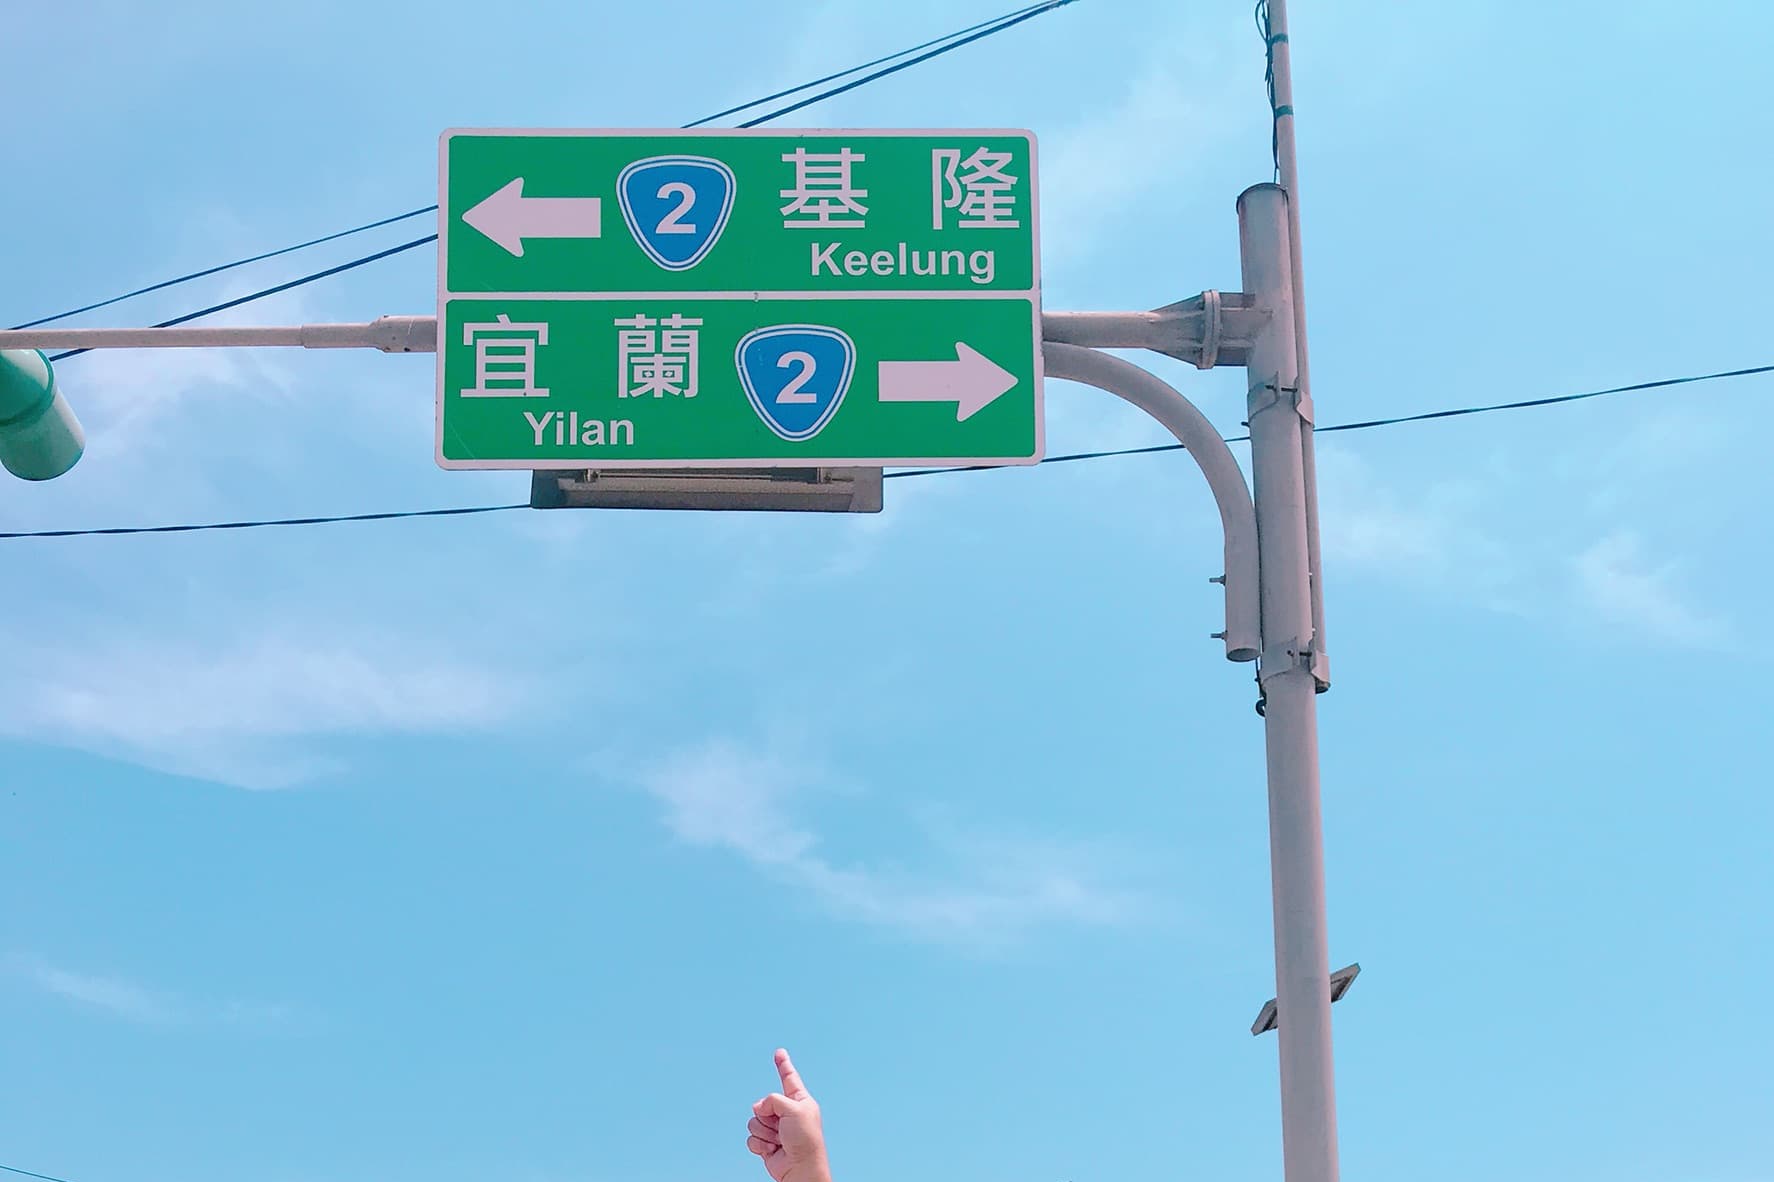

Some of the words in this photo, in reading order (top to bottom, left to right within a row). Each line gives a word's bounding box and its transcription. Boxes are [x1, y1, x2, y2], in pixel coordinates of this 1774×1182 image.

[654, 182, 697, 235] 2
[780, 146, 1020, 230] 基隆
[811, 242, 995, 284] Keelung
[460, 313, 703, 398] 宜蘭
[775, 351, 817, 404] 2
[523, 411, 634, 445] Yilan
